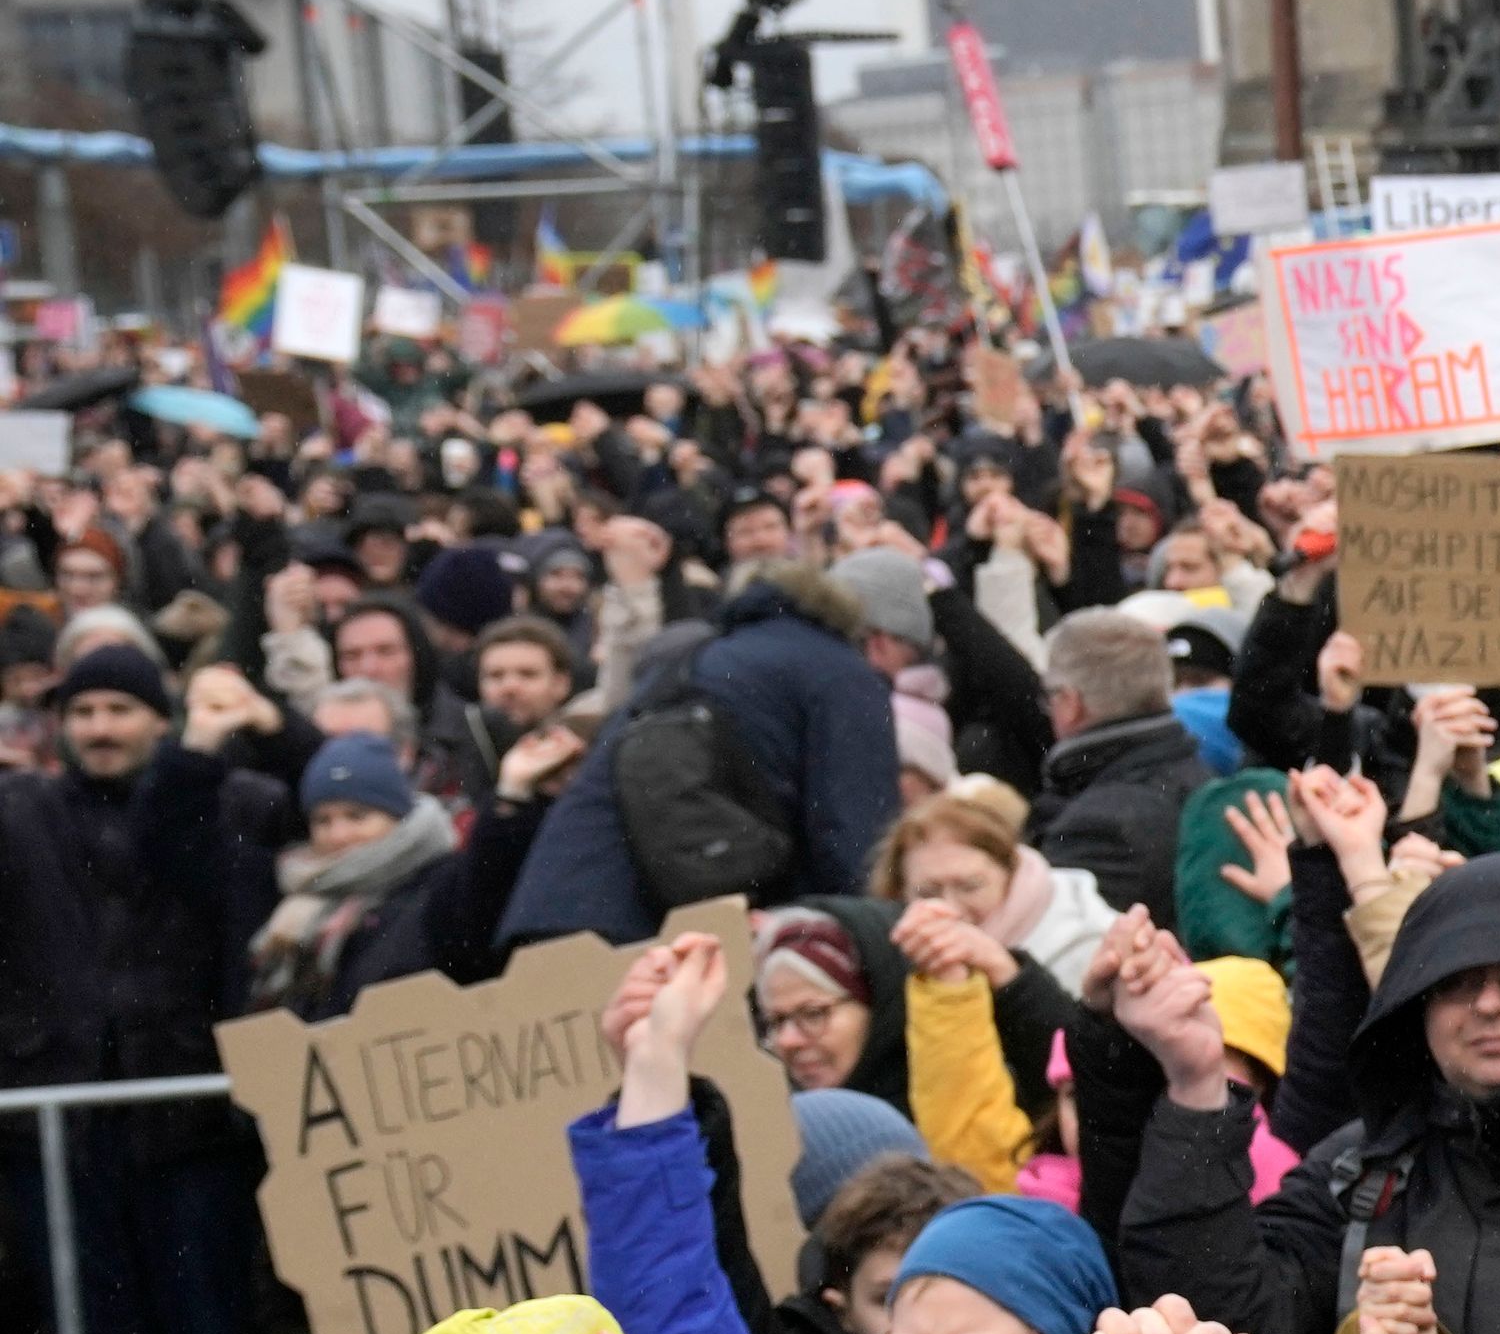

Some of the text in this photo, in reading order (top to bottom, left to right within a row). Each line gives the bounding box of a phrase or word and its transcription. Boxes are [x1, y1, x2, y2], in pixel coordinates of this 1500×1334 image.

[1290, 252, 1407, 315] NAZIS
[1322, 343, 1494, 430] HARAM
[1363, 575, 1427, 616] AUF
[297, 1007, 617, 1156] ALTERNATI
[325, 1150, 470, 1257] FÜR
